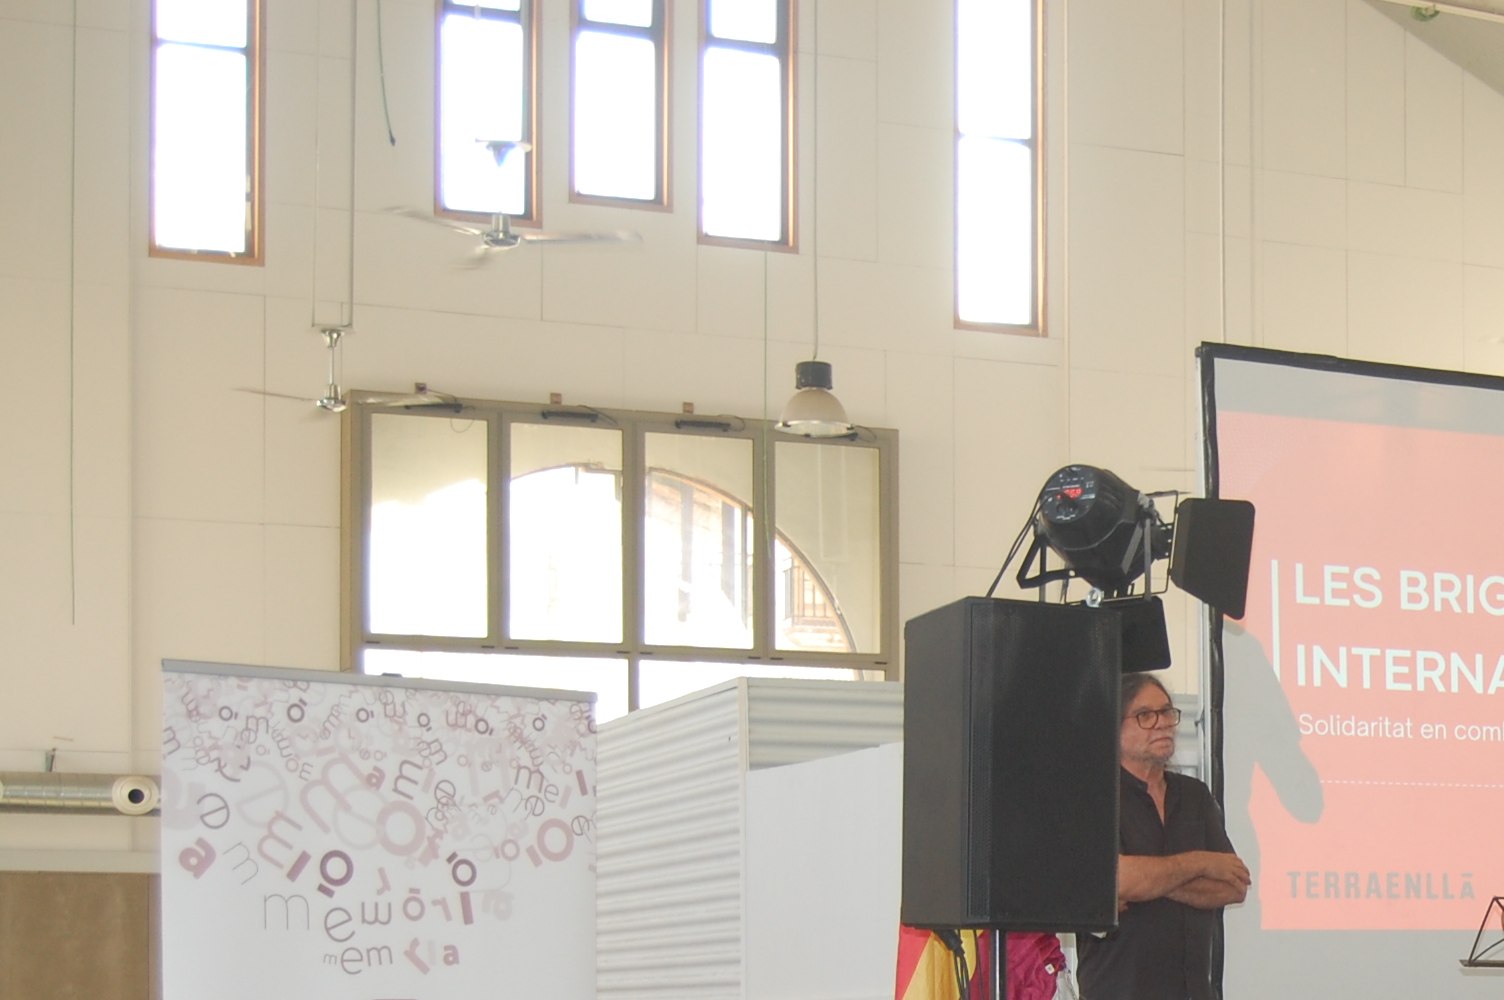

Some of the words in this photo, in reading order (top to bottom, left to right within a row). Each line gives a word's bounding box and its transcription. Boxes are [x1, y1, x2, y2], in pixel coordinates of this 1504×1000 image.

[1295, 562, 1383, 608] LES
[1298, 713, 1414, 739] Solidaritat
[1420, 723, 1448, 740] en
